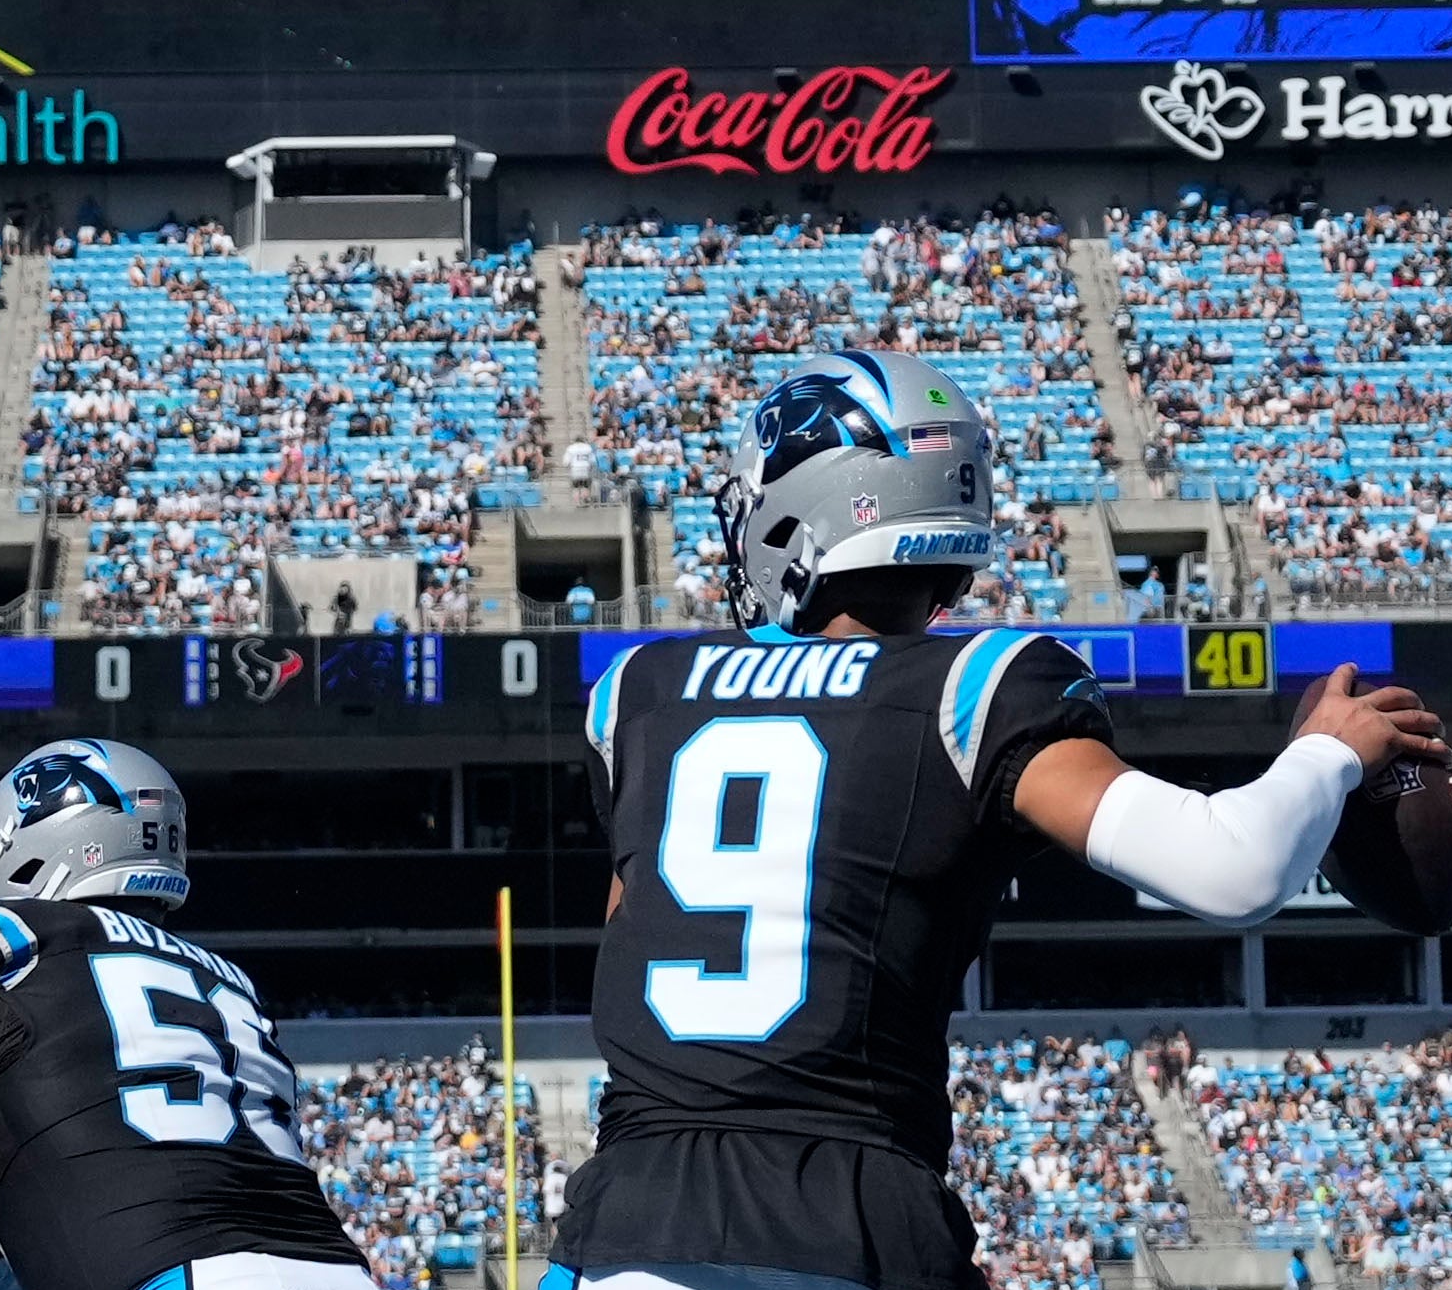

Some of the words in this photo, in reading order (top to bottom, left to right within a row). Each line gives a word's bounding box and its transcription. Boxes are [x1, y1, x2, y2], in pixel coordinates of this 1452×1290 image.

[606, 65, 954, 176] Coca-Cola
[959, 463, 976, 504] 9
[855, 508, 878, 523] NFL
[892, 531, 992, 562] PANTHERS
[96, 645, 131, 702] 0
[501, 639, 539, 698] 0
[681, 641, 883, 701] YOUNG
[1196, 631, 1265, 688] 40
[141, 821, 180, 853] 56
[125, 872, 188, 895] PANTHERS
[643, 715, 830, 1043] 9
[87, 953, 312, 1169] 56
